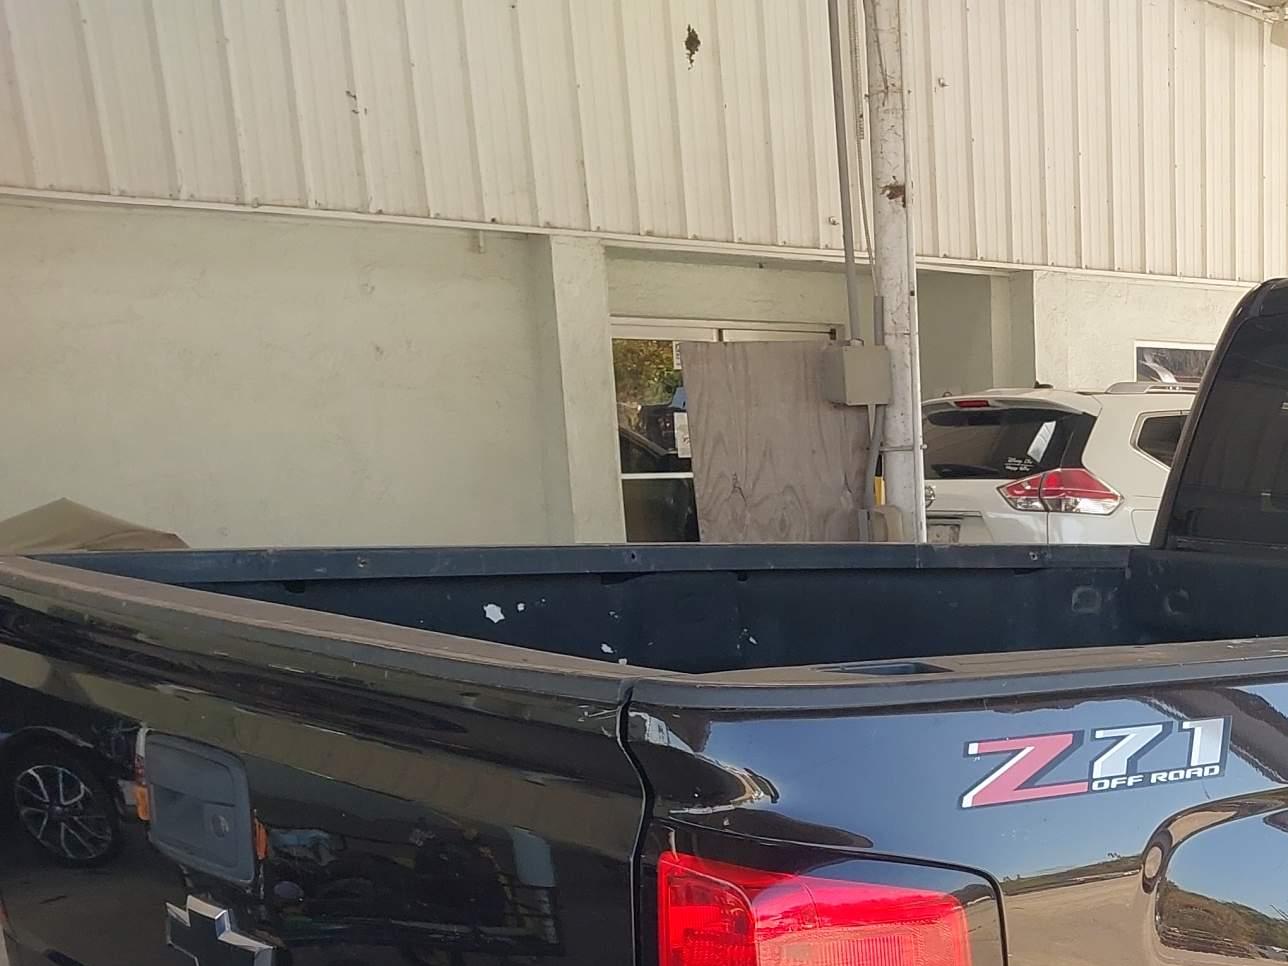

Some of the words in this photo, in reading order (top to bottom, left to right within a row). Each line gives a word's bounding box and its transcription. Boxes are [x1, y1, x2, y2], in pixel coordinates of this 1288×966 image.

[959, 716, 1230, 809] Z71
[1092, 775, 1144, 792] OFF
[1150, 764, 1221, 785] ROAD
